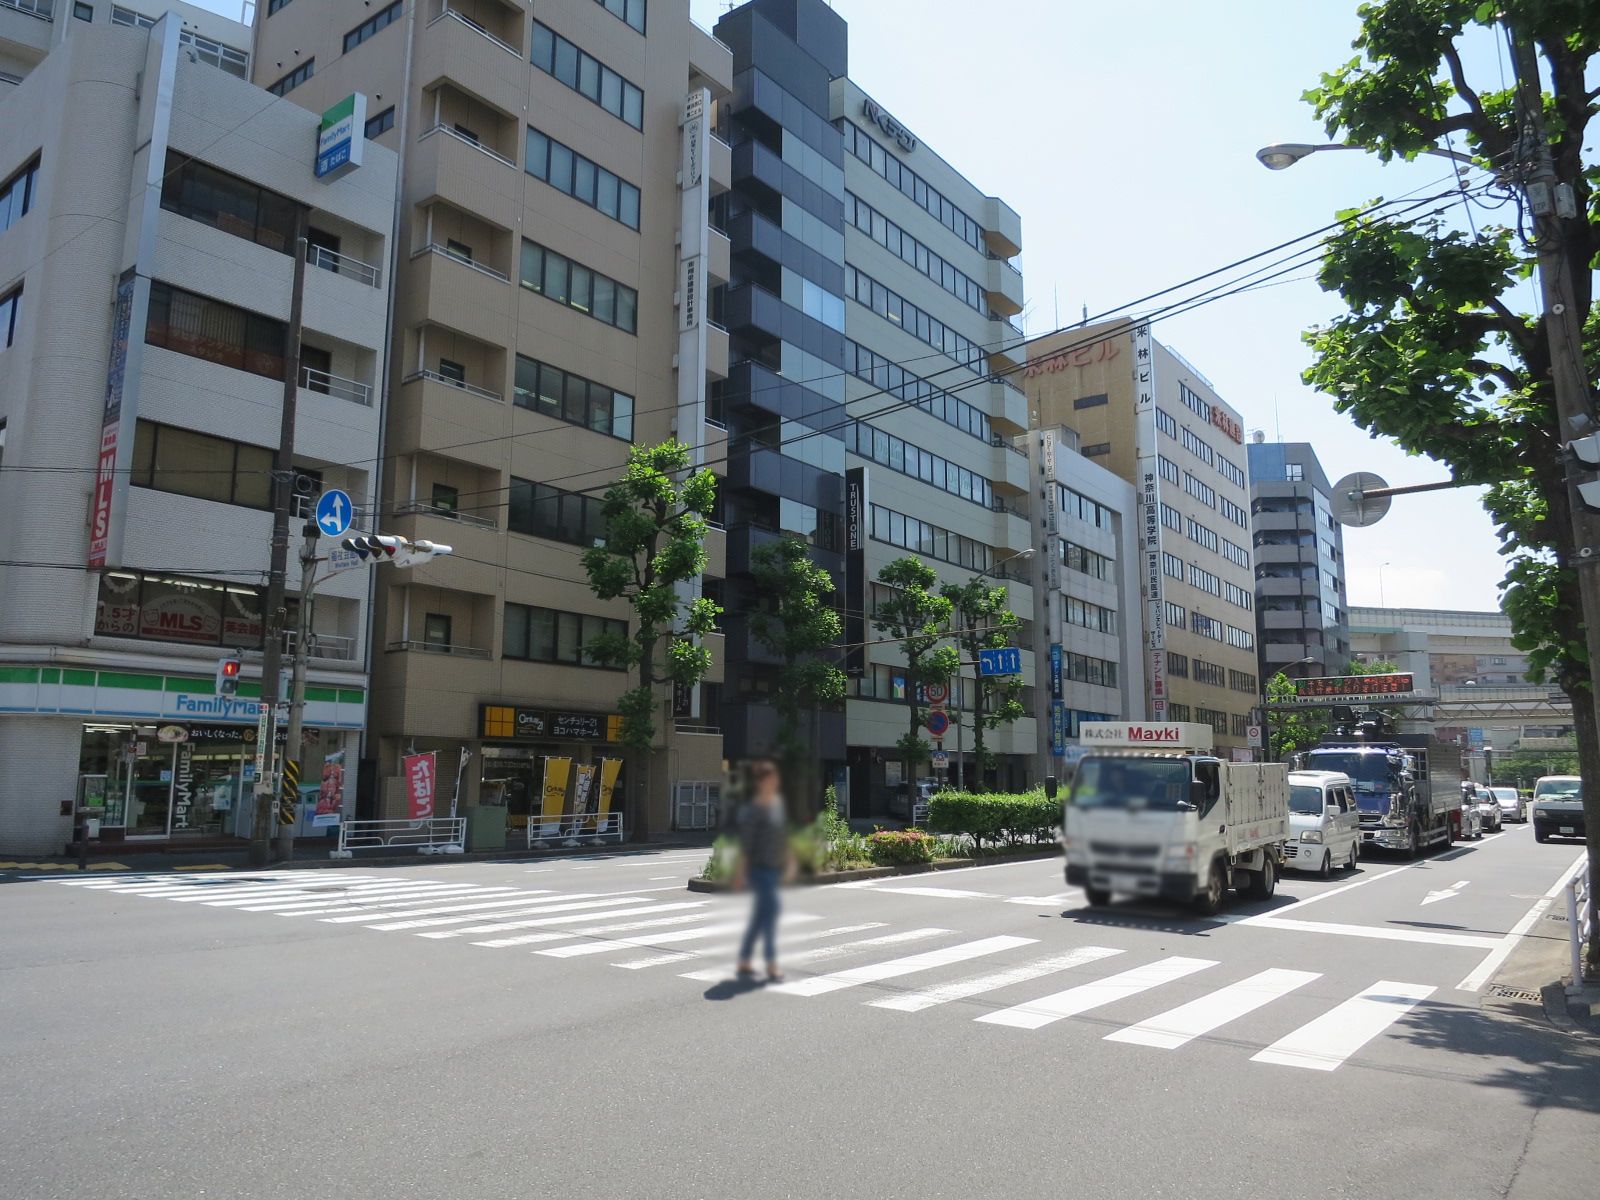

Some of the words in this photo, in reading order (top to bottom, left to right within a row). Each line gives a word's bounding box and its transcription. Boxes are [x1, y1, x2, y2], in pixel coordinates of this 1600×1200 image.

[95, 454, 114, 538] MLS
[849, 483, 857, 524] TRUST
[849, 524, 857, 548] ONE
[160, 611, 203, 631] MLS
[553, 726, 599, 737] ヨコハマホーム
[1085, 728, 1122, 739] 株式会社
[1128, 727, 1179, 741] Mayki
[175, 742, 196, 828] FamilyMart
